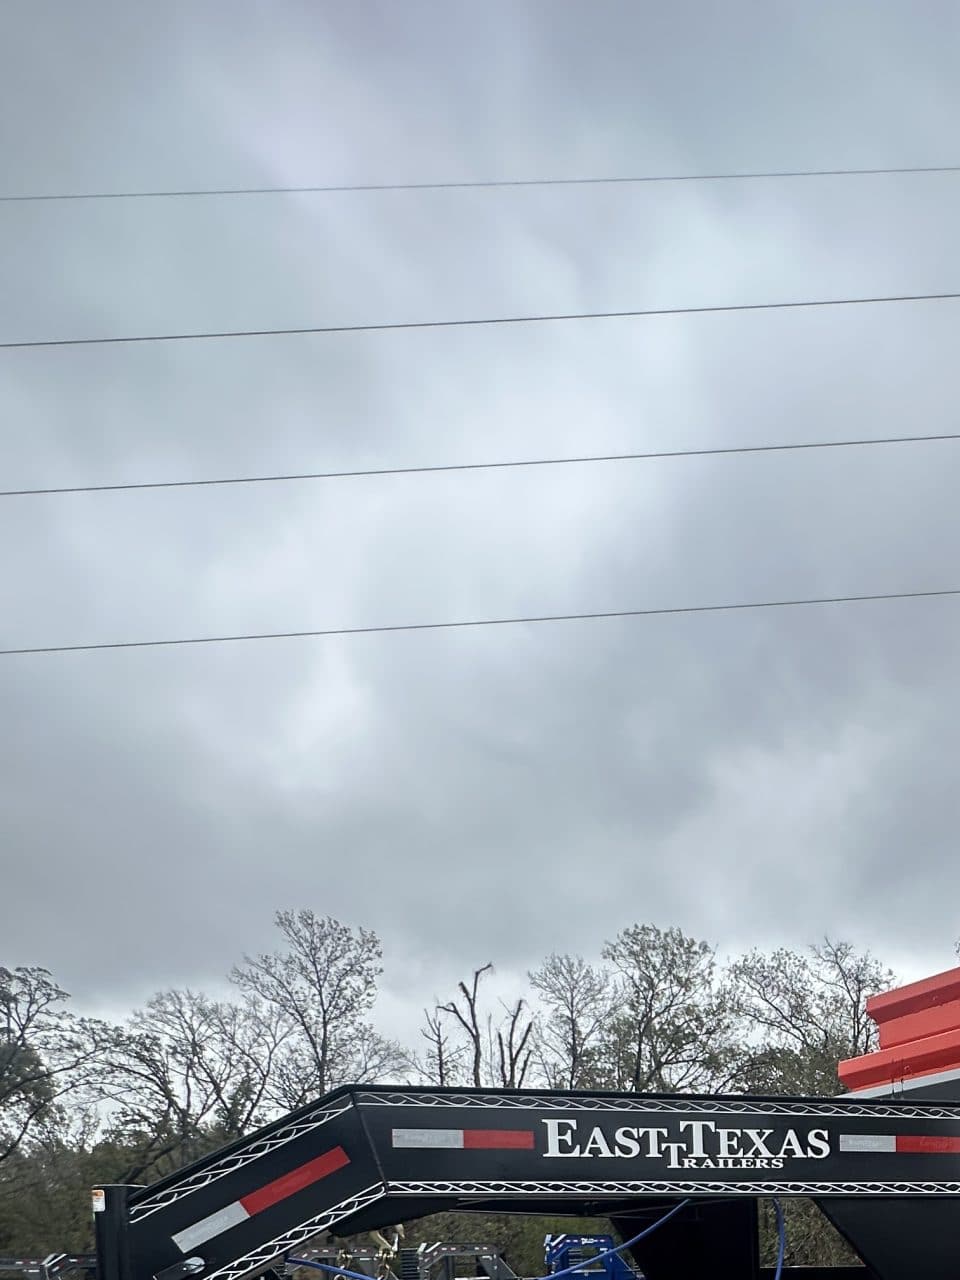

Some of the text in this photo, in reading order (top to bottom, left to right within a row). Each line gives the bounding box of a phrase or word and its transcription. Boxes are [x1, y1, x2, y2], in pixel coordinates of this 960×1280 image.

[541, 1118, 831, 1158] EAST TEXAS
[661, 1142, 784, 1169] TRAILERS
